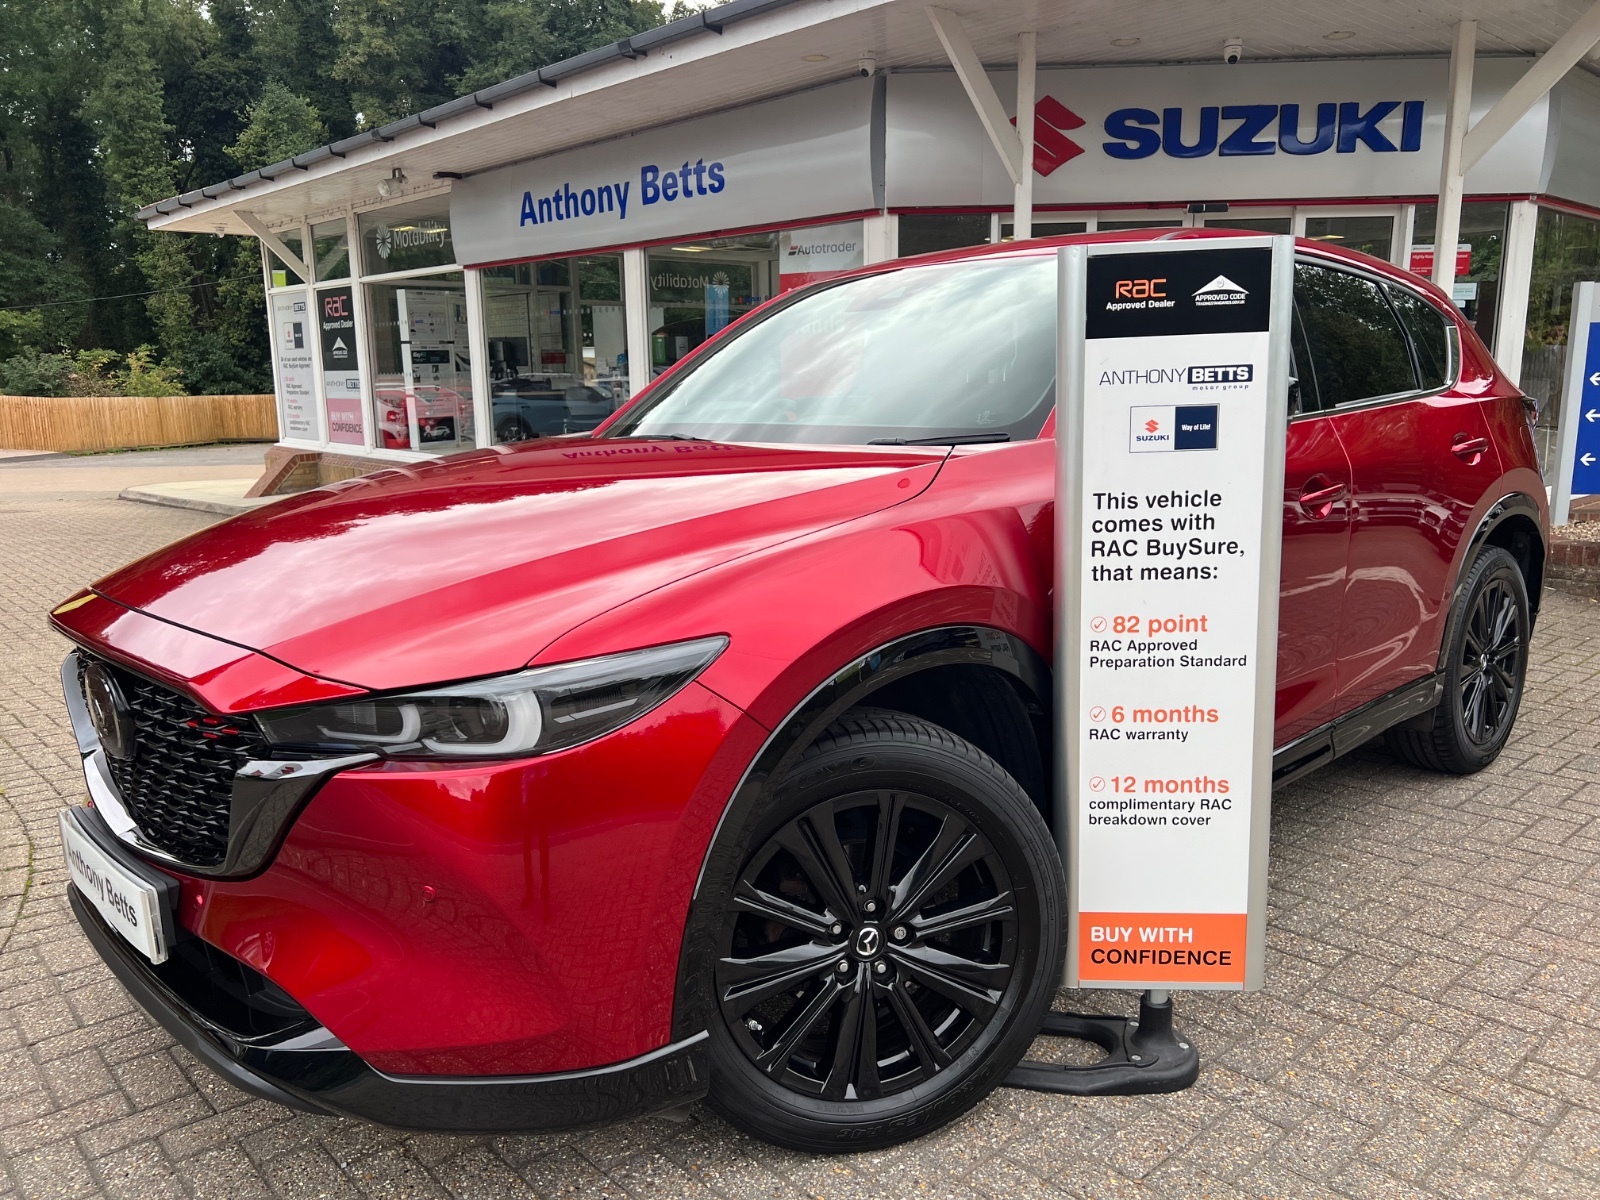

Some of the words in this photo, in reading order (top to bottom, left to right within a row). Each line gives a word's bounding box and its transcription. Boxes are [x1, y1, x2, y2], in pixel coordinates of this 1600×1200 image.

[1102, 101, 1425, 160] SUZUKI
[519, 181, 630, 227] Anthony
[641, 158, 725, 206] Betts
[393, 222, 446, 250] Motability
[797, 240, 857, 256] Autotrader
[1115, 278, 1167, 299] RAC
[1106, 301, 1146, 311] Approved
[1148, 299, 1176, 309] Dealer
[1195, 293, 1228, 302] APPROVED
[325, 296, 349, 317] RAC
[323, 320, 341, 331] Approved
[341, 319, 354, 329] Dealer
[1099, 367, 1186, 386] ANTHONY
[1191, 366, 1249, 383] BETTS
[332, 422, 363, 434] CONFIDENCE
[1181, 424, 1193, 432] Way
[1193, 423, 1199, 431] of
[1135, 434, 1170, 442] SUZUKI
[1092, 491, 1139, 510] This
[1145, 489, 1222, 509] vehicle
[1091, 518, 1163, 533] comes
[1170, 513, 1216, 531] with
[1091, 539, 1138, 557] RAC
[1146, 537, 1245, 560] BuySure,
[1091, 564, 1133, 581] that
[1140, 565, 1219, 580] means:
[1112, 615, 1140, 634] 82
[1148, 614, 1208, 638] point
[1090, 639, 1122, 652] RAC
[1127, 638, 1198, 654] Approved
[1090, 656, 1174, 671] Preparation
[1179, 654, 1247, 667] Standard
[1111, 705, 1125, 724] 6
[1132, 704, 1219, 723] months
[1089, 728, 1121, 740] RAC
[1126, 728, 1189, 742] warranty
[1111, 775, 1136, 793] 12
[1144, 775, 1230, 794] months
[1089, 798, 1195, 813] complimentary
[1200, 798, 1232, 810] RAC
[1089, 814, 1167, 825] breakdown
[1171, 816, 1212, 826] cover
[66, 838, 105, 902] Anthony
[105, 877, 138, 928] Betts
[1090, 926, 1132, 943] BUY
[1138, 926, 1193, 943] WITH
[1091, 948, 1232, 966] CONFIDENCE
